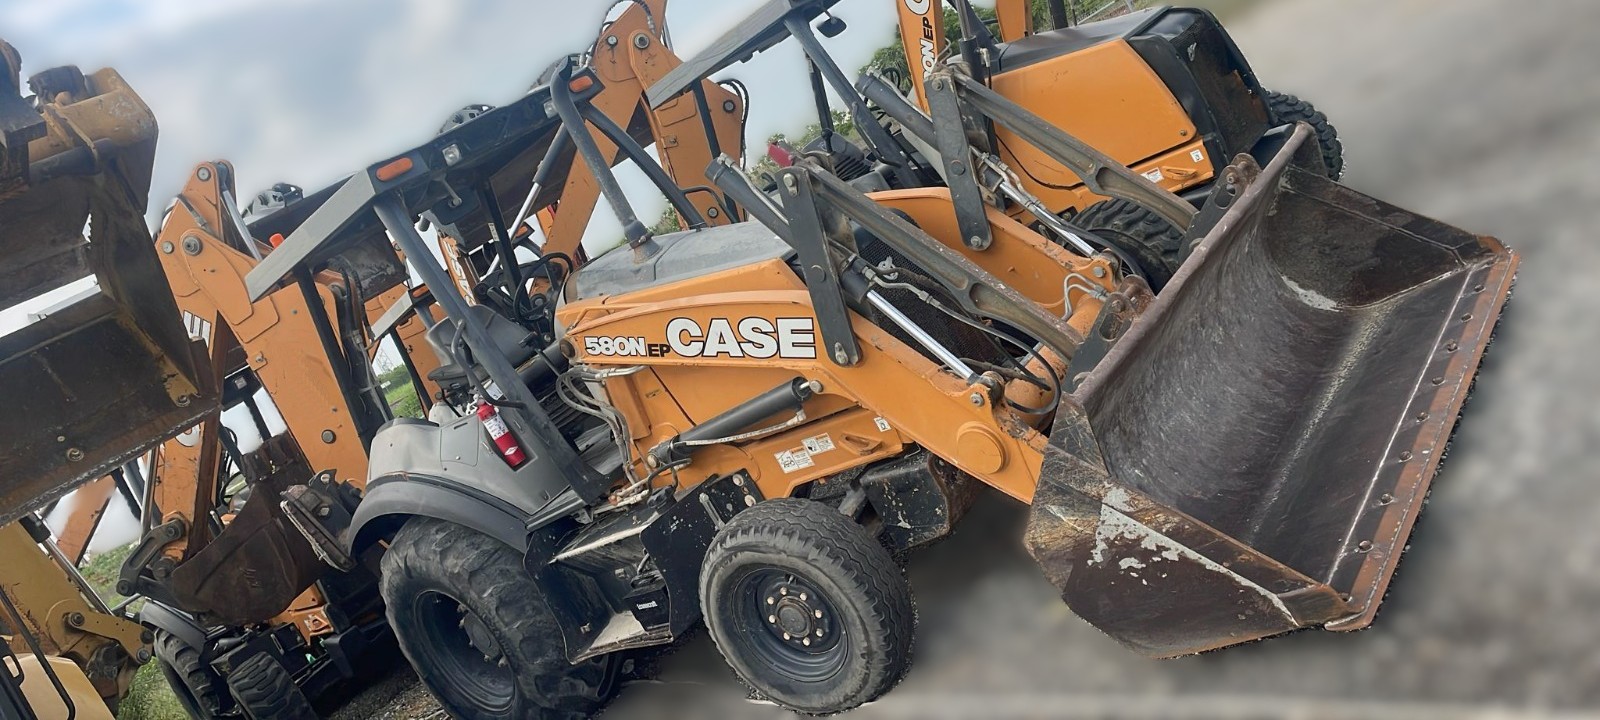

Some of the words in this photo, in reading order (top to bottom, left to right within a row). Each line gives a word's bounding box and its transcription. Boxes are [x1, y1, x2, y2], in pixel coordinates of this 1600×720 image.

[922, 16, 934, 41] EP
[584, 336, 646, 357] 580N
[648, 343, 671, 358] EP
[665, 316, 817, 360] CASE
